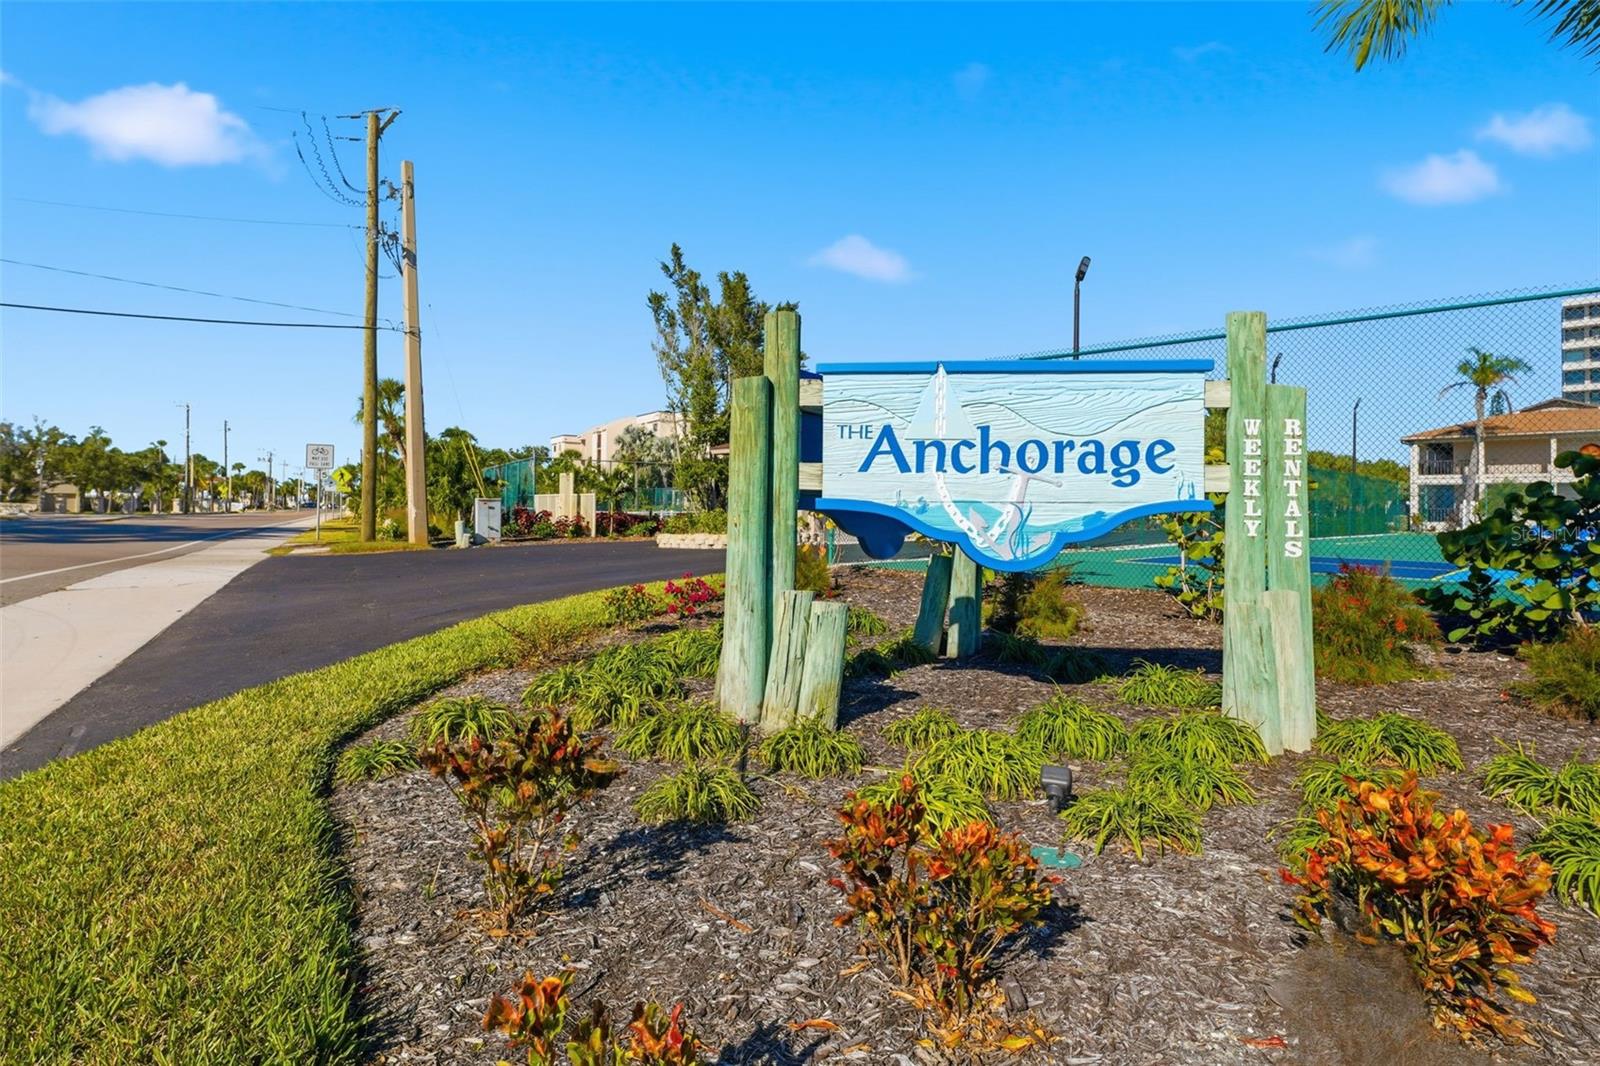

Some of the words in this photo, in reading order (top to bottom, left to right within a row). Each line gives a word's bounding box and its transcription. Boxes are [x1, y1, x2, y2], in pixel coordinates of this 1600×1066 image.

[837, 425, 873, 440] THE
[858, 424, 1176, 487] Anchorage
[1243, 418, 1261, 537] WEEKLY
[1283, 418, 1303, 558] RENTALS
